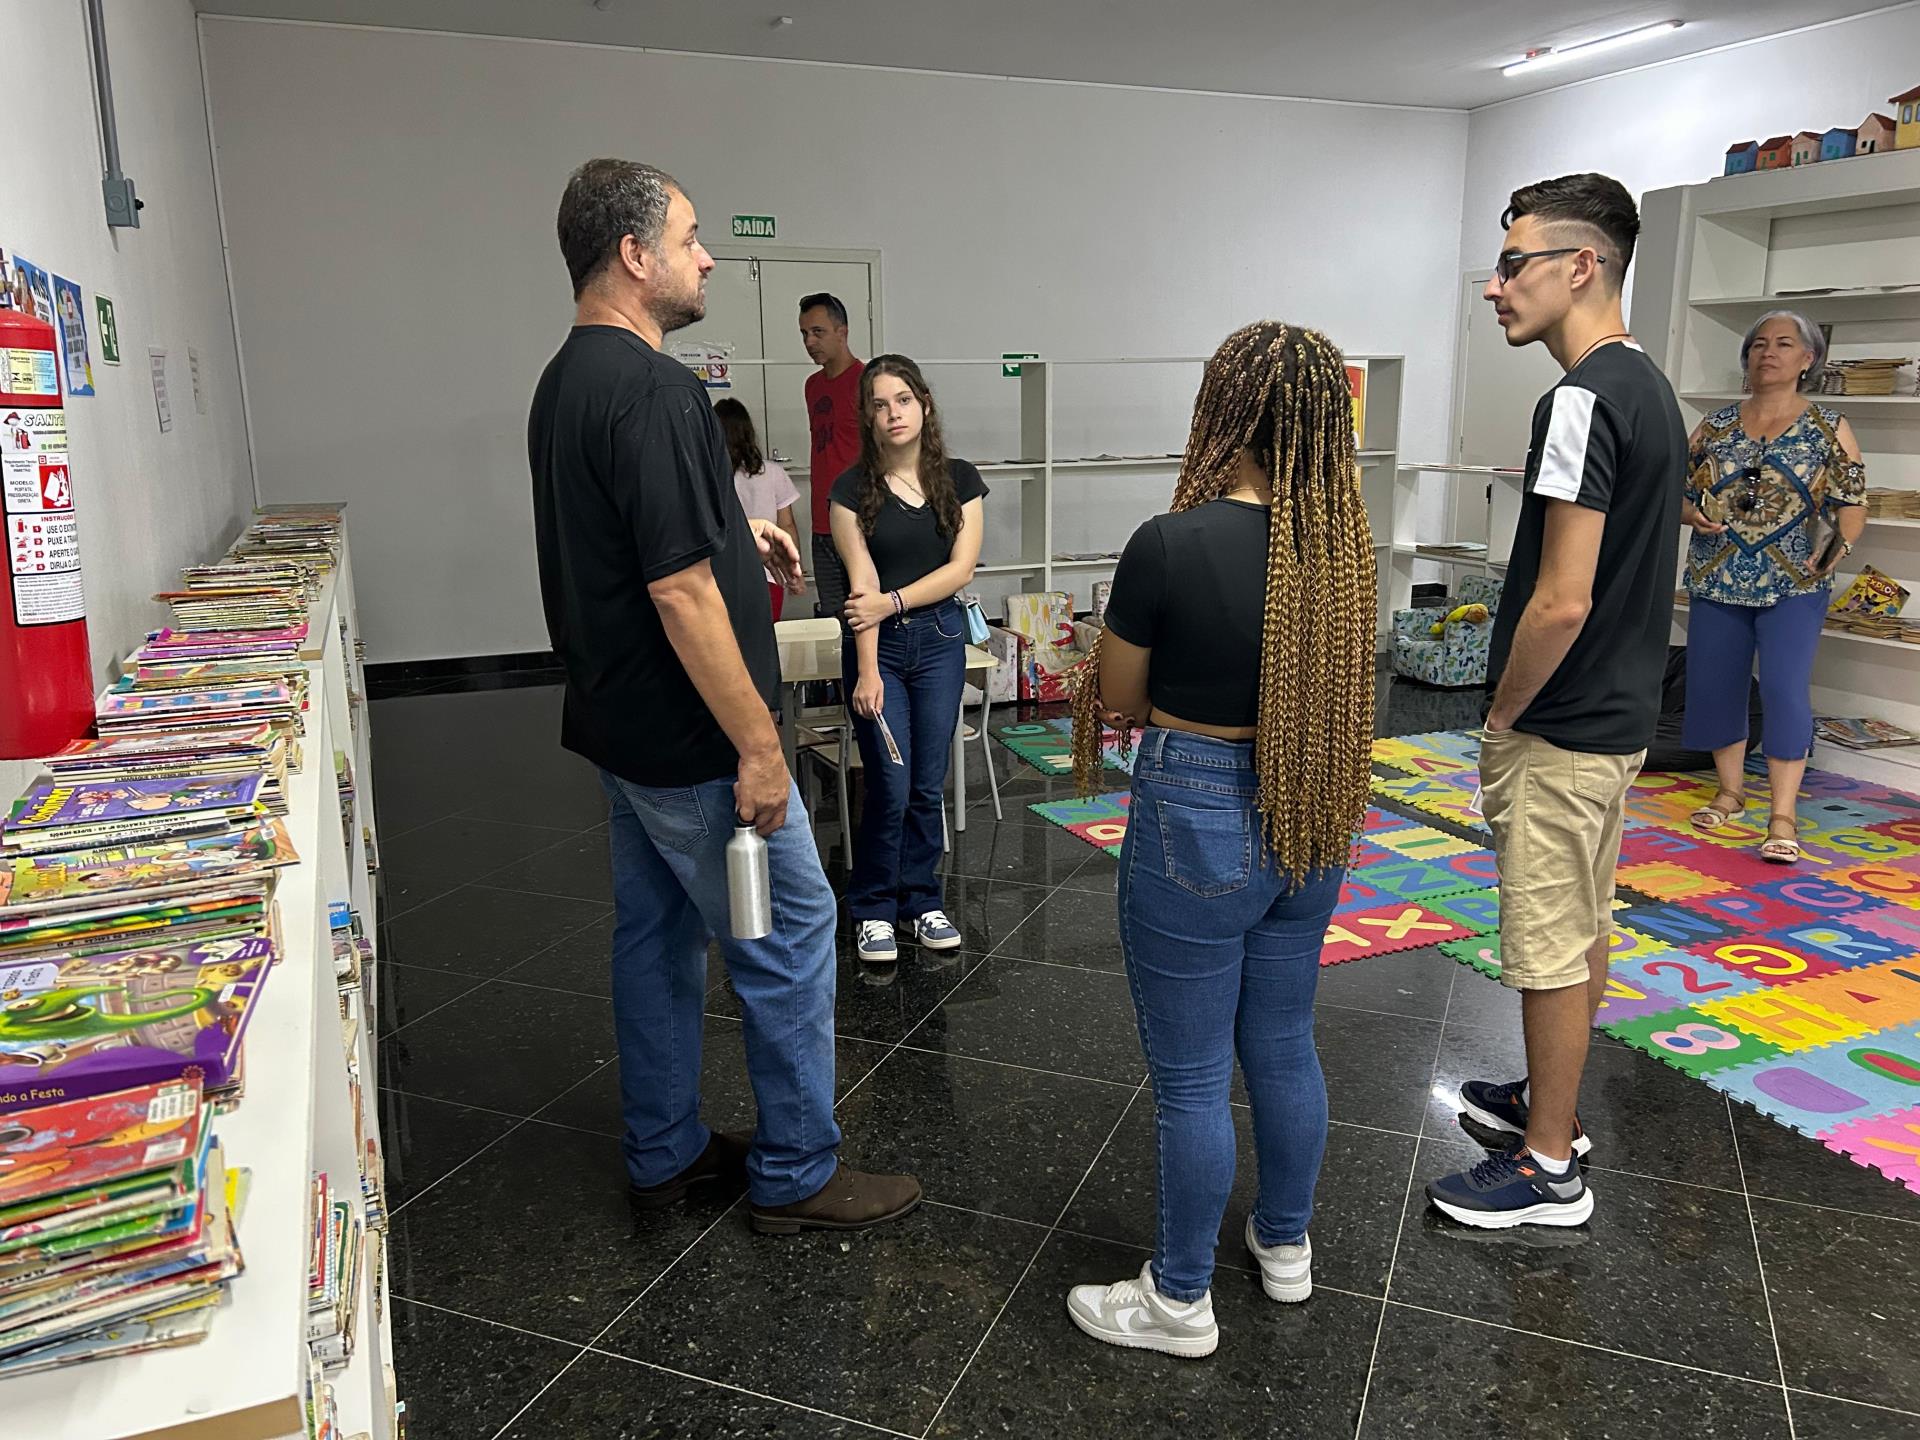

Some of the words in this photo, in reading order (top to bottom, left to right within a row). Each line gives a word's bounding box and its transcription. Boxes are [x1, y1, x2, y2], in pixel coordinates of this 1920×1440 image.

[734, 218, 775, 236] SAÍDA
[46, 525, 58, 534] USE
[48, 536, 63, 545] PUXE
[1780, 882, 1864, 908] G
[1357, 908, 1453, 939] X
[1788, 927, 1893, 959] R
[1641, 960, 1733, 994] 2
[1724, 997, 1842, 1041] H
[1650, 1022, 1741, 1056] 8
[20, 1093, 28, 1102] a
[30, 1088, 65, 1100] Festa
